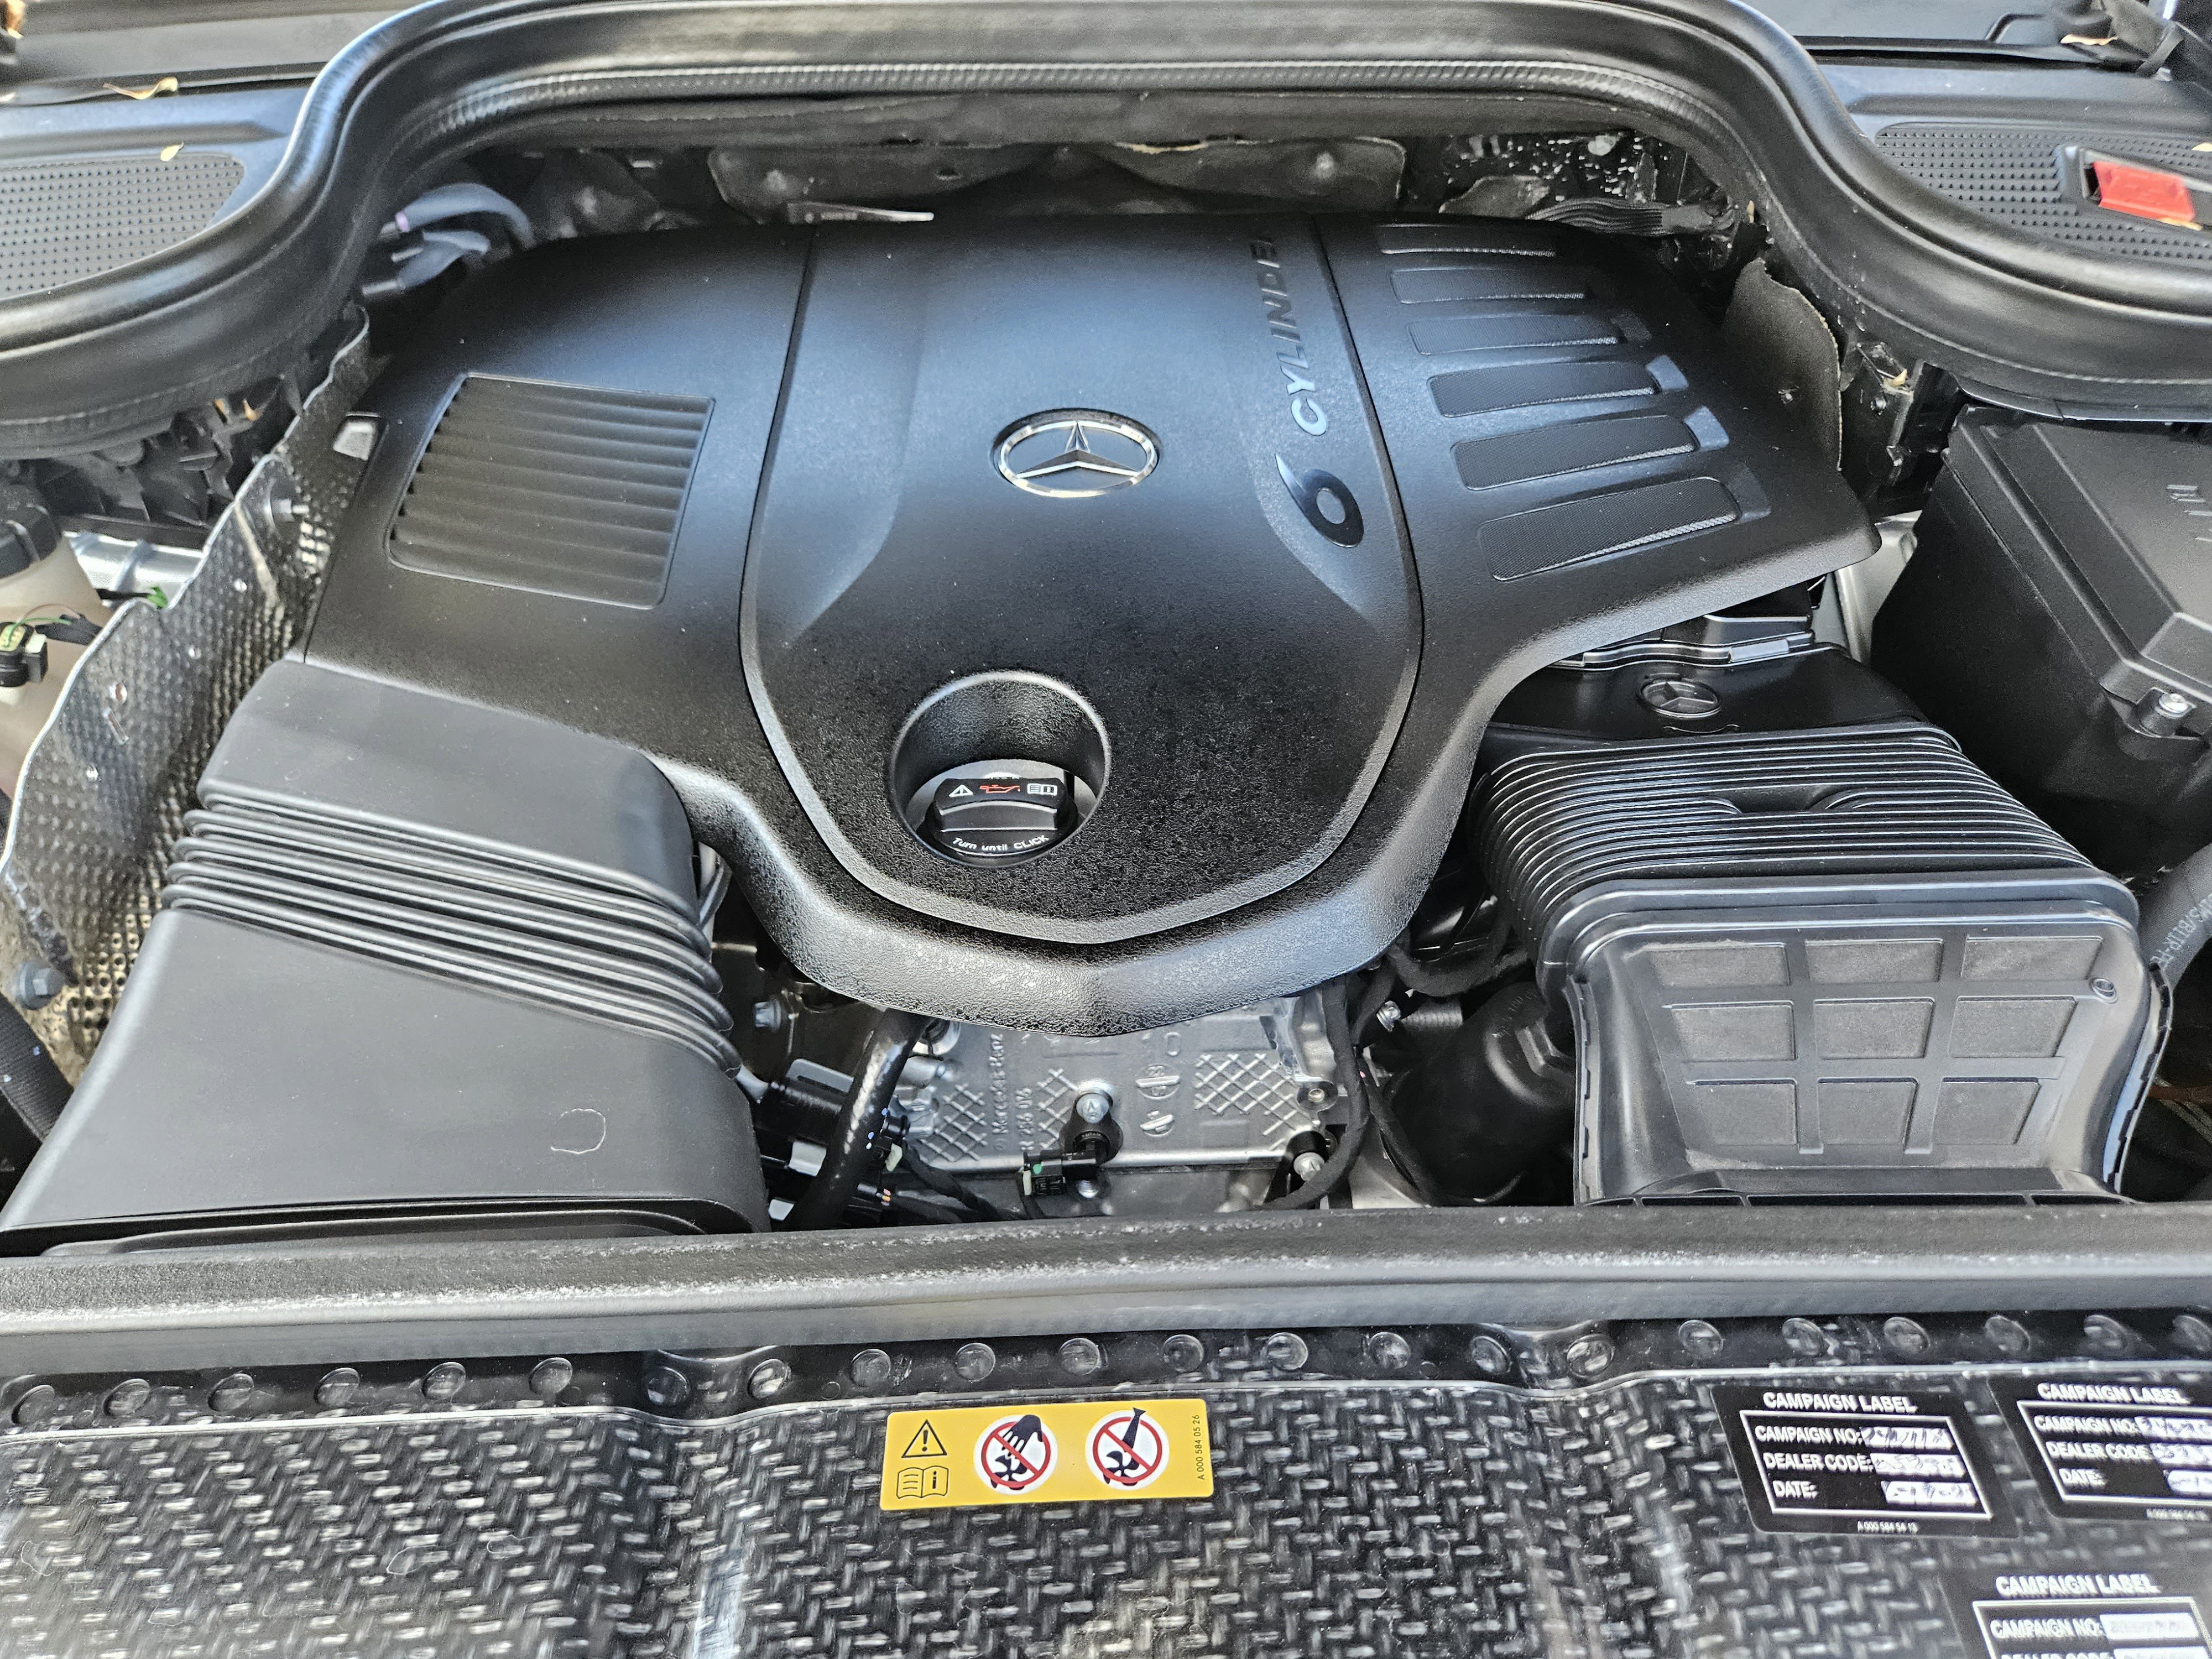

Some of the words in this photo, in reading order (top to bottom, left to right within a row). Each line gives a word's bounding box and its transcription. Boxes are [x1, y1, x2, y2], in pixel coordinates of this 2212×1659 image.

[1275, 453, 1364, 548] 6
[952, 837, 977, 849] Turn
[1013, 834, 1049, 849] CLICK
[1763, 1392, 1858, 1411] CAMPAIGN
[1860, 1396, 1918, 1413] LABEL
[2037, 1383, 2132, 1402] CAMPAIGN
[2131, 1386, 2192, 1405] LABEL
[1192, 1414, 1200, 1425] 26
[2034, 1415, 2112, 1433] CAMPAIGN
[1193, 1427, 1201, 1437] 05
[1755, 1425, 1834, 1443] CAMPAIGN
[1833, 1427, 1862, 1445] NO:
[1194, 1439, 1203, 1454] 584
[2046, 1441, 2107, 1459] DEALER
[1195, 1457, 1204, 1472] 000
[1763, 1453, 1824, 1470] DEALER
[1824, 1454, 1874, 1472] CODE:
[1773, 1480, 1817, 1499] DATE:
[1864, 1521, 1879, 1533] 000
[1995, 1574, 2096, 1598] CAMPAIGN
[2095, 1573, 2161, 1595] LABEL
[1990, 1618, 2075, 1639] CAMPAIGN
